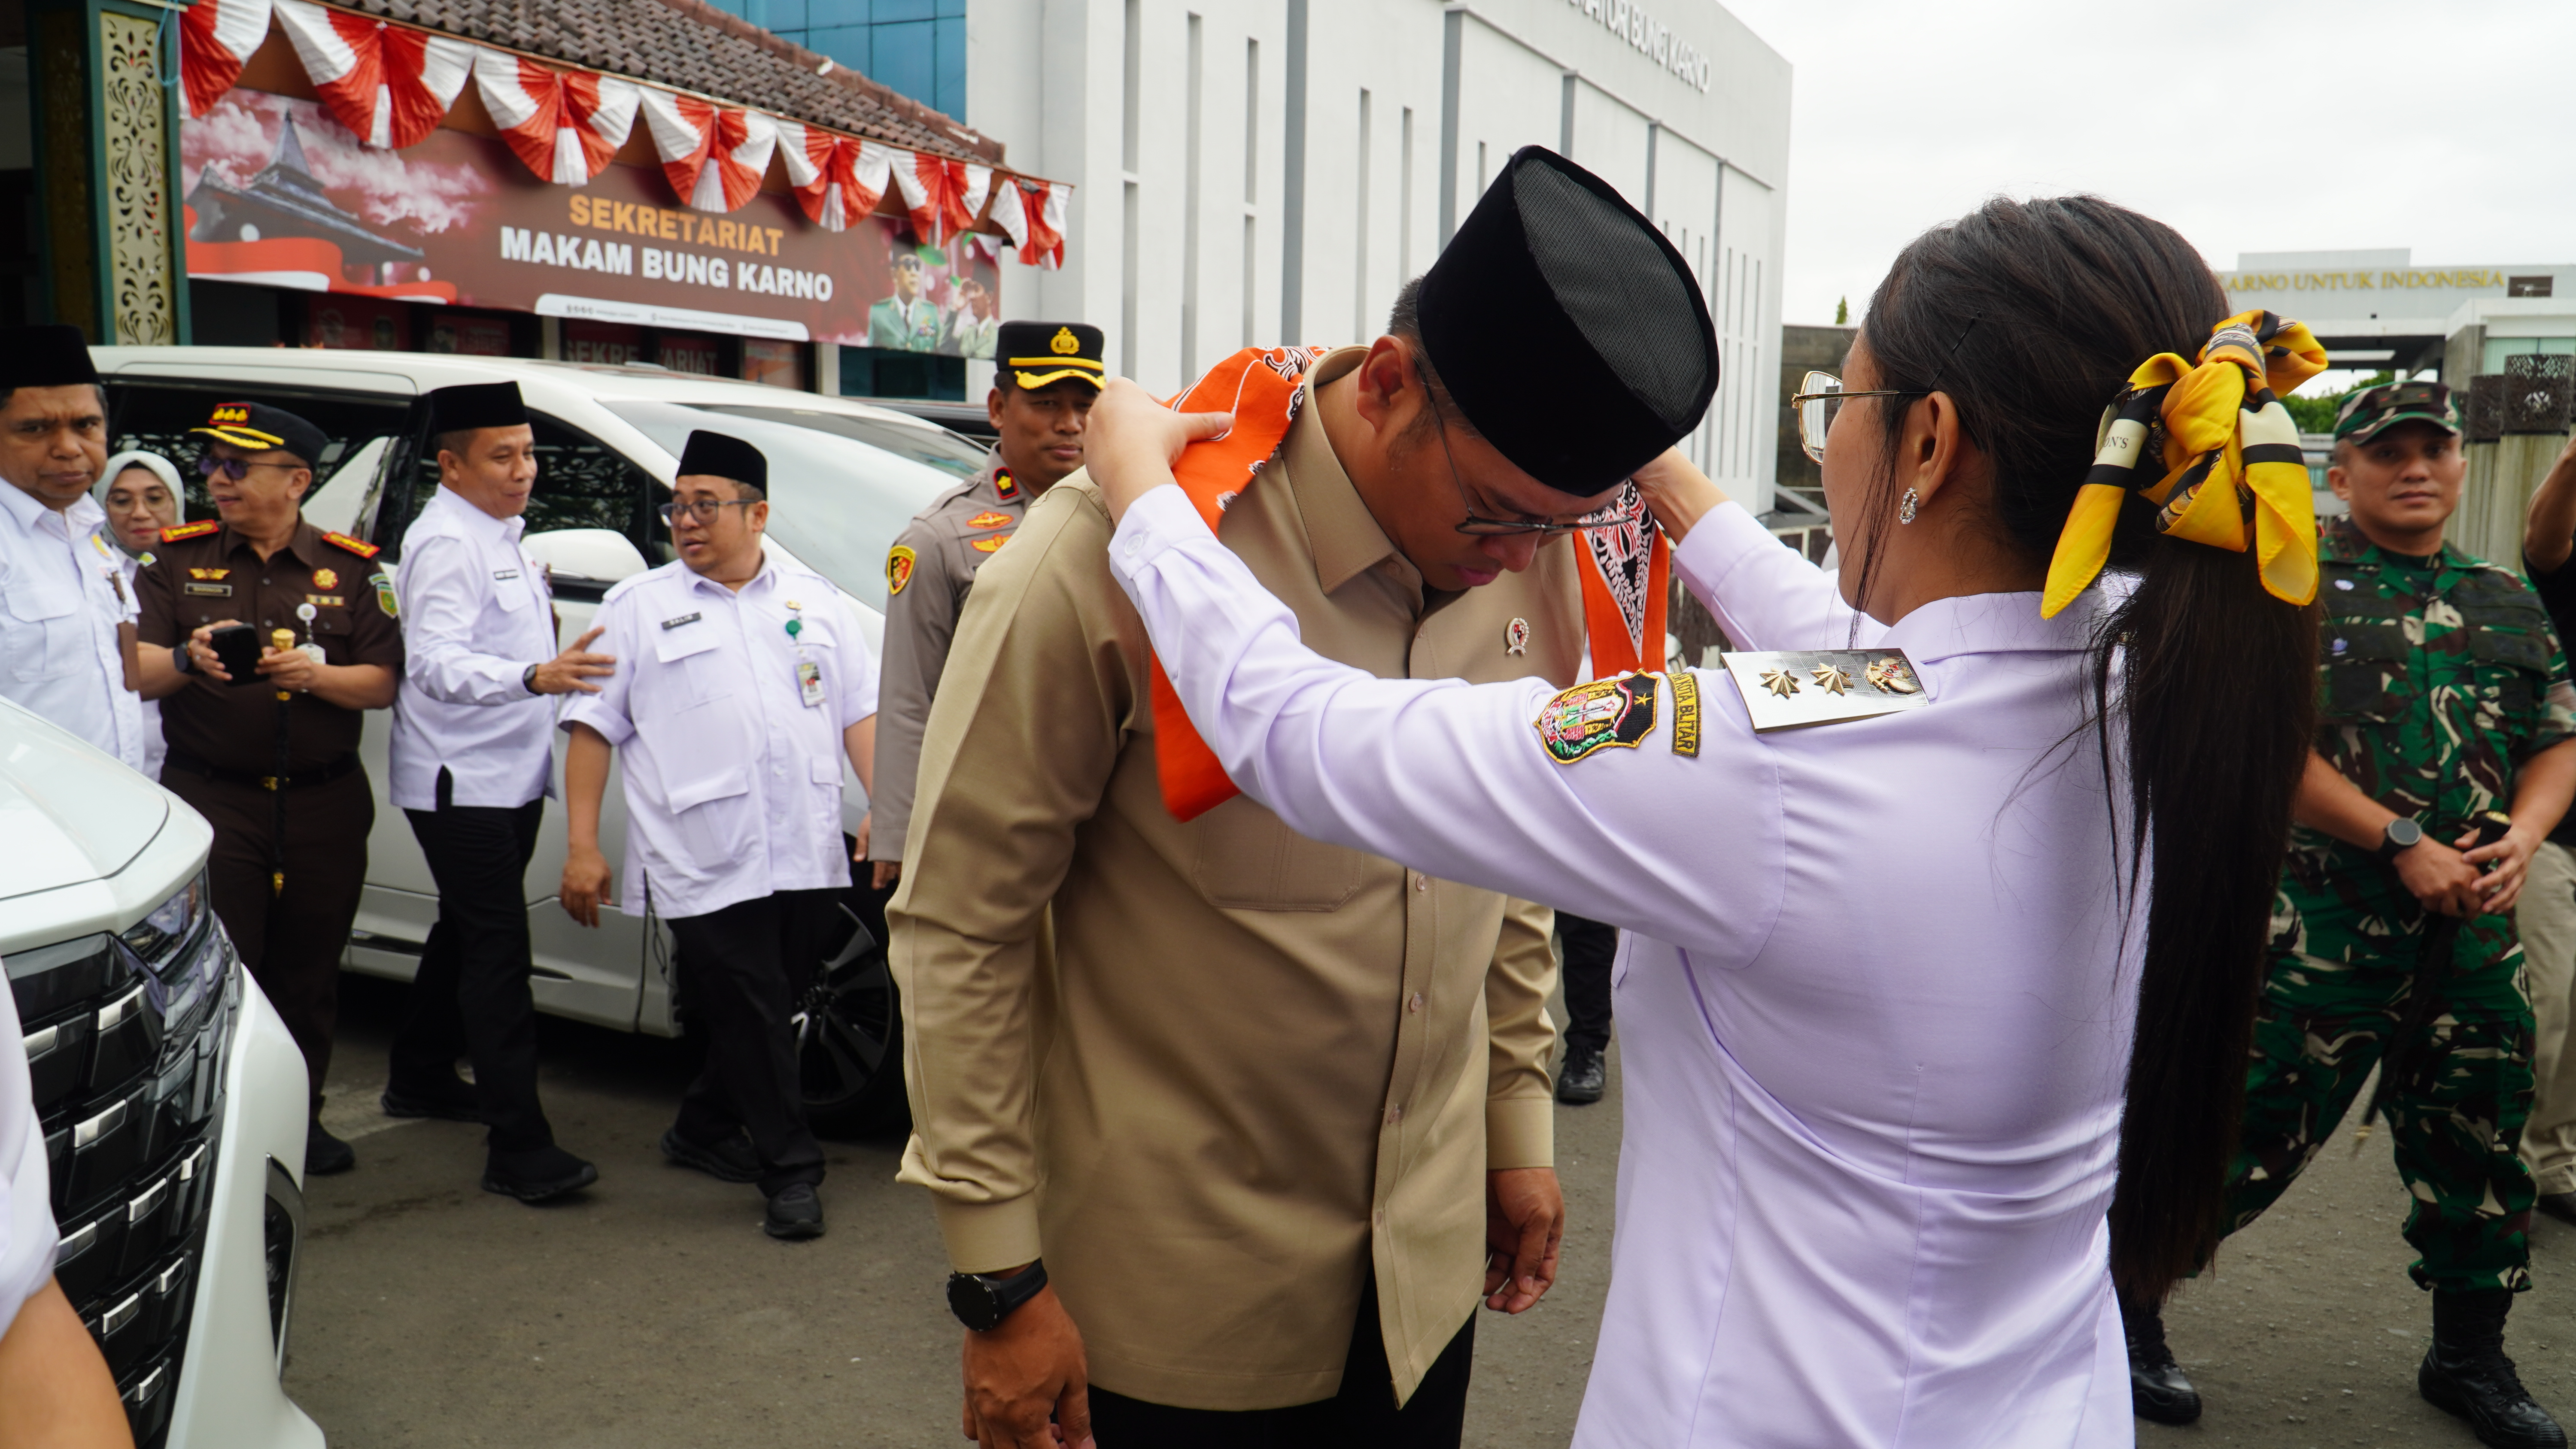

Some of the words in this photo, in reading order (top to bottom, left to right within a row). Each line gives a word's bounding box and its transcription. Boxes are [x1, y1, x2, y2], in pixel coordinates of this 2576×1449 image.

[1631, 4, 1668, 65] BUNG
[1668, 32, 1711, 94] KARNO
[569, 194, 784, 256] SEKRETARIAT
[500, 226, 633, 276] MAKAM
[642, 247, 729, 288] BUNG
[737, 261, 833, 302] KARNO
[2293, 271, 2374, 291] UNTUK
[2381, 270, 2505, 288] INDONESIA
[1677, 705, 1695, 749] BLITAR
